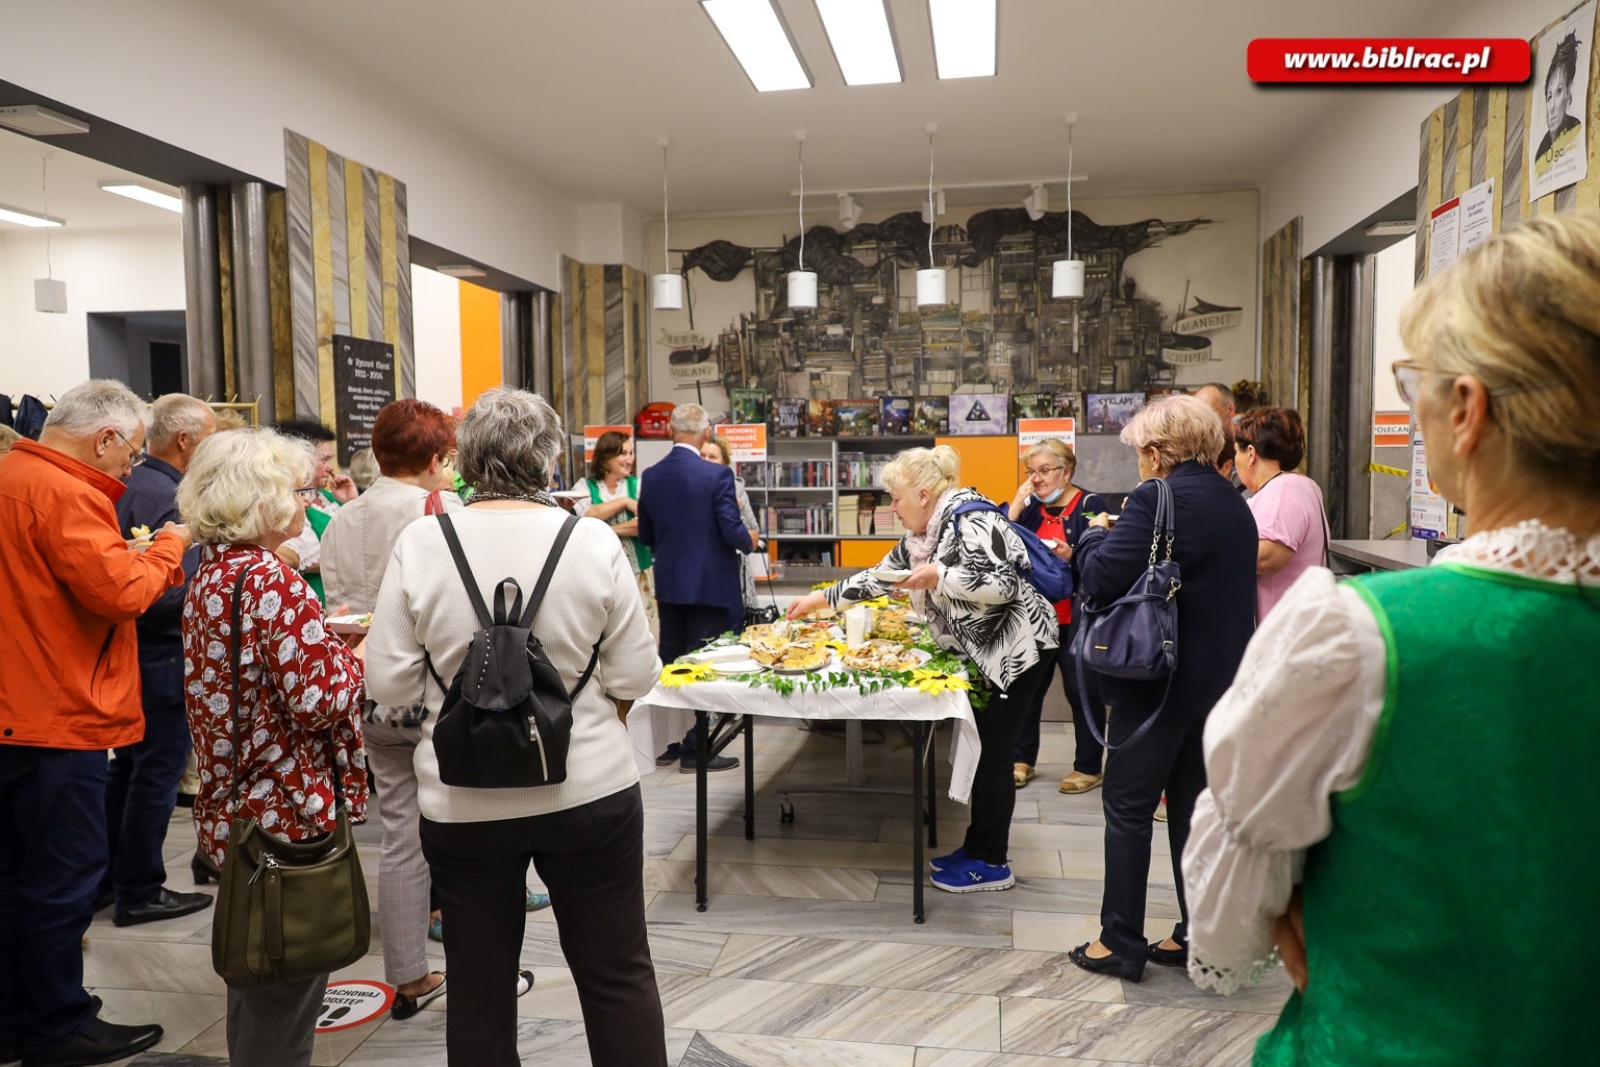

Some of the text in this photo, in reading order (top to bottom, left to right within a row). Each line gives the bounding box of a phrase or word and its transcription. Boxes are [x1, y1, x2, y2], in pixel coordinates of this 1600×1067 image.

[1181, 313, 1233, 332] MANENT
[667, 334, 705, 346] VERBA
[1163, 349, 1210, 364] SCRIPTA
[670, 367, 714, 378] VOLANT
[324, 989, 381, 998] ZACHOWAJ
[323, 997, 364, 1006] ODSTĘP
